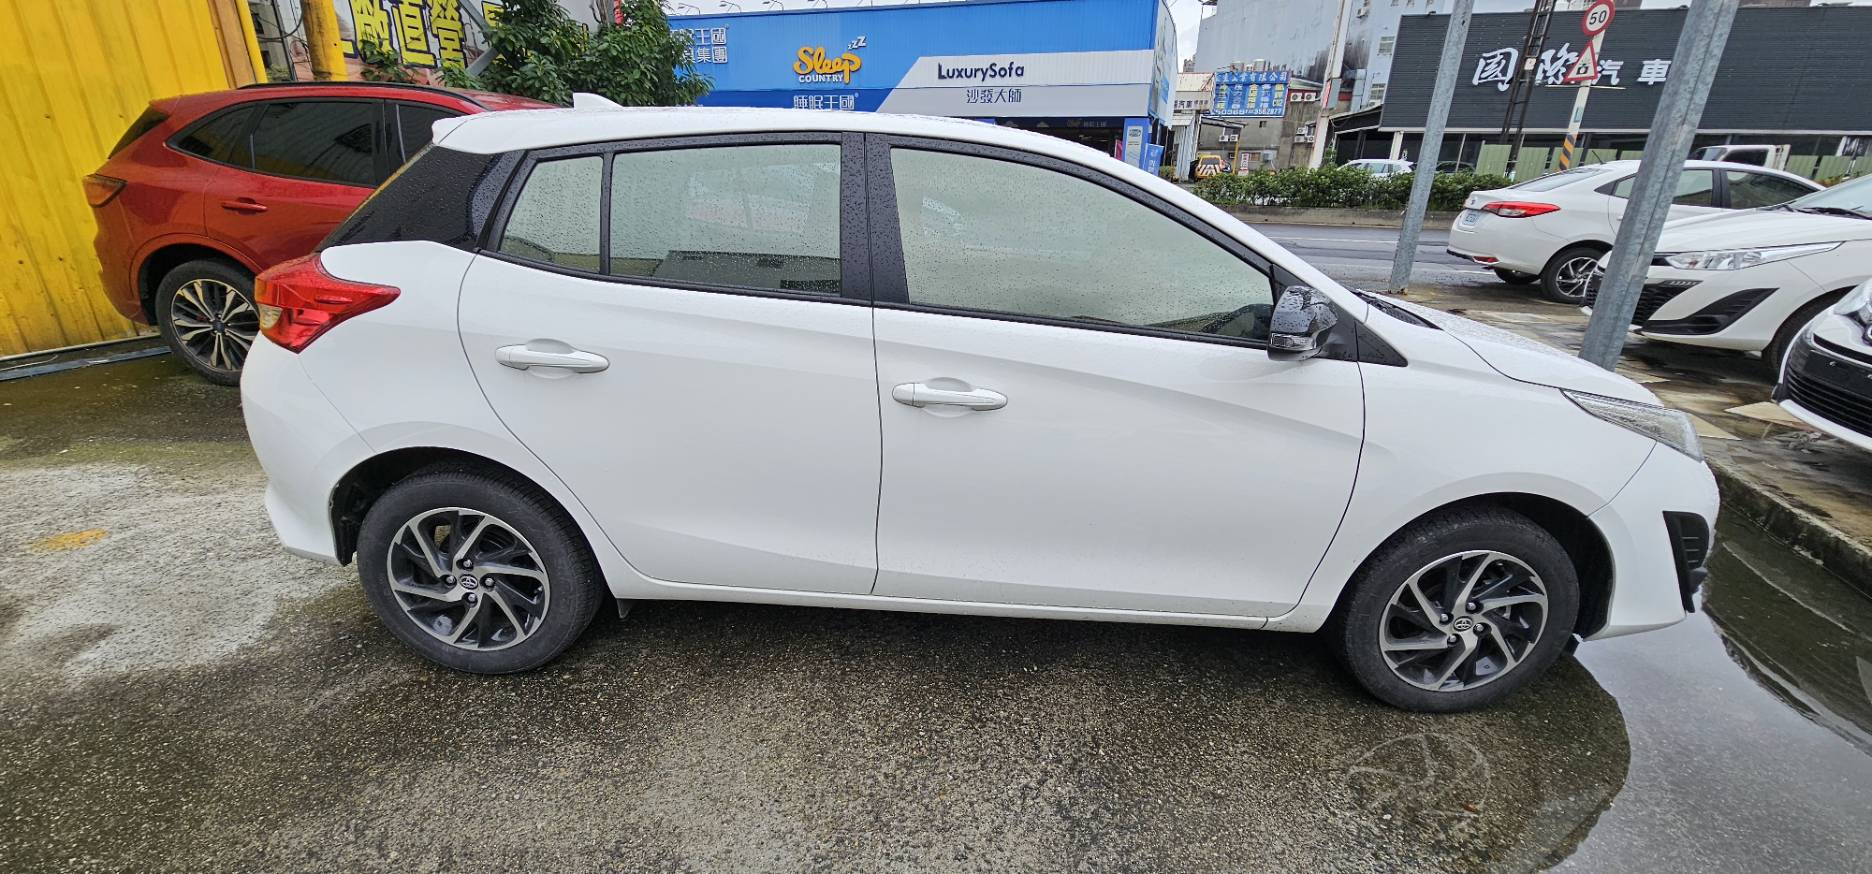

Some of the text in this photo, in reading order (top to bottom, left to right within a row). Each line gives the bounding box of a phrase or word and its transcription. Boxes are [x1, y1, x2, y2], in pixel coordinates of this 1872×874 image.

[1589, 10, 1607, 25] 50
[793, 46, 862, 84] Sleep
[938, 61, 1024, 82] LuxurySofa
[798, 74, 844, 83] COUNTRY
[966, 87, 1022, 104] 沙發大師
